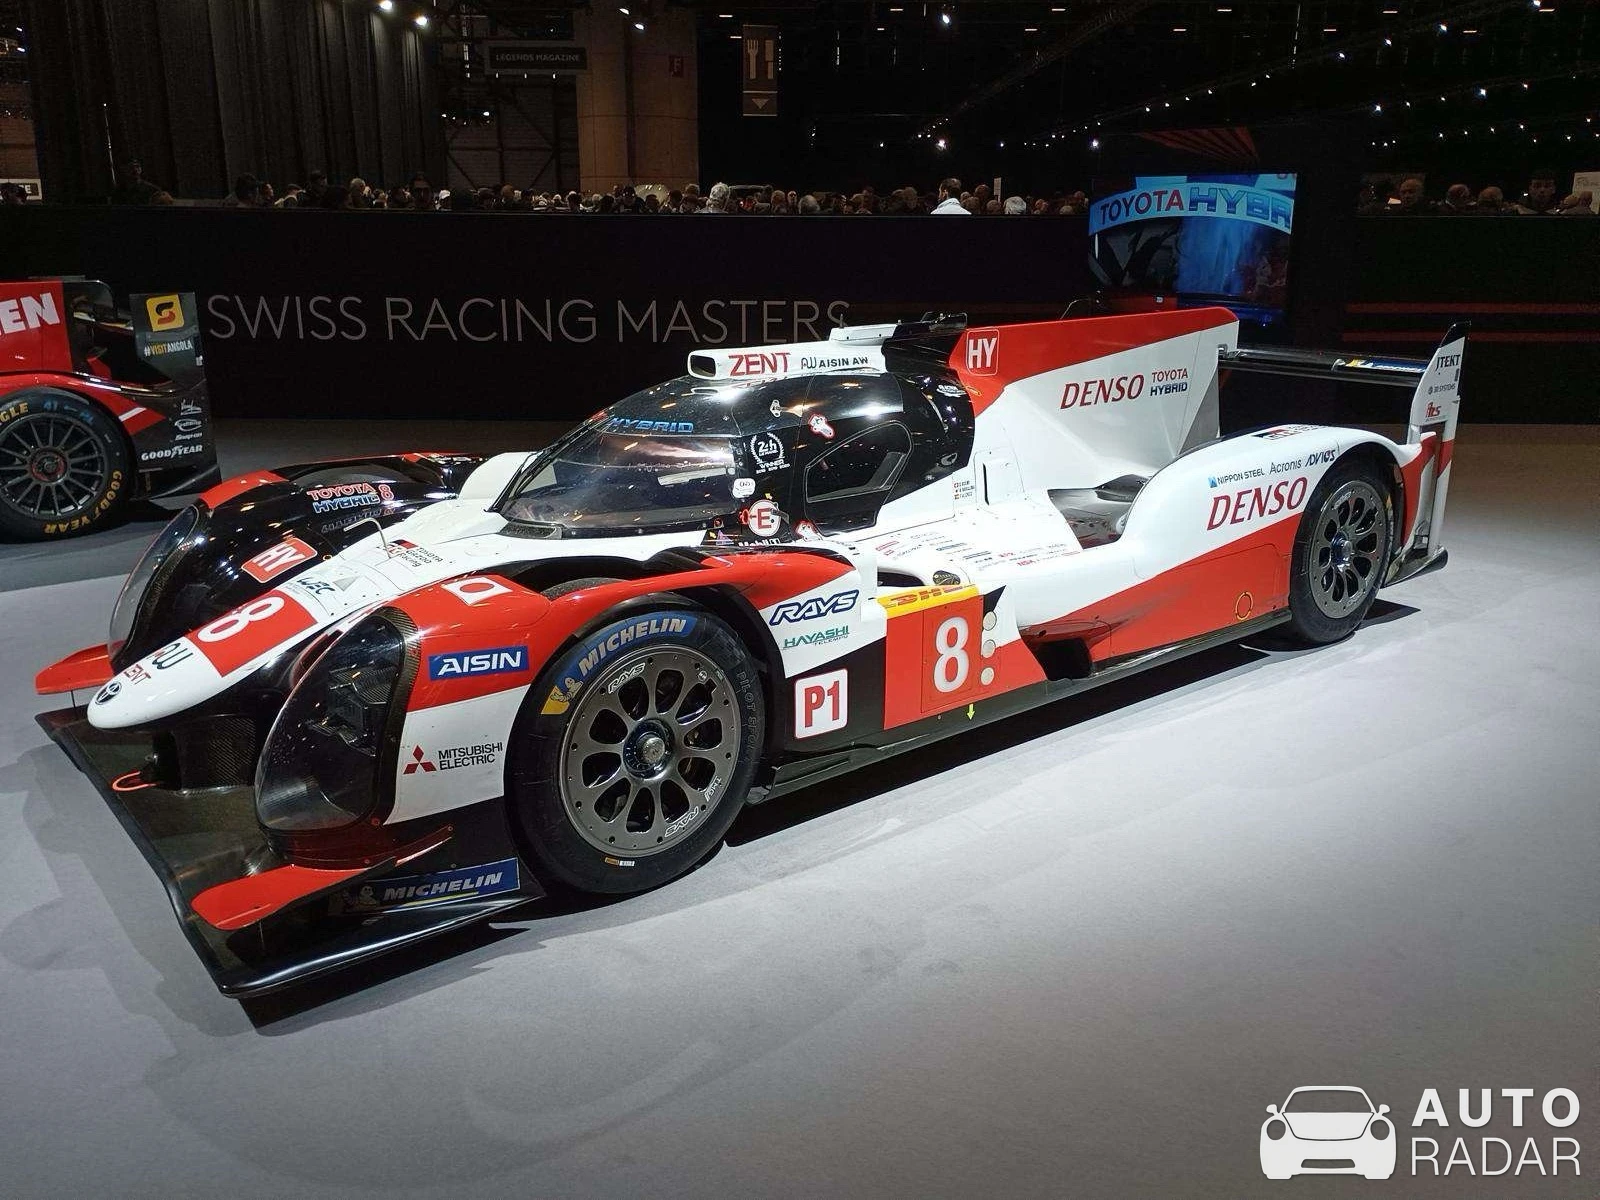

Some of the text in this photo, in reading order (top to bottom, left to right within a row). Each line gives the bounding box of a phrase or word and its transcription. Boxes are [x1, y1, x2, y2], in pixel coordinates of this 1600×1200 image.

[495, 53, 581, 63] LEGENDS MAGAZINE
[1100, 189, 1184, 224] TOYOTA
[0, 291, 60, 335] EN
[207, 294, 850, 343] SWISS RACING MASTERS
[144, 340, 193, 357] #VISITANGOLA
[967, 337, 997, 369] HY
[728, 352, 791, 377] ZENT
[818, 357, 849, 368] AISIN
[851, 356, 869, 366] AW
[1435, 354, 1461, 371] JTEKT
[1151, 368, 1189, 383] TOYOTA
[1060, 374, 1145, 409] DENSO
[1150, 381, 1188, 397] HYBRID
[610, 417, 694, 433] HYBRID
[141, 444, 203, 461] GOODYEAR
[1216, 472, 1244, 486] NIPPON
[1244, 468, 1266, 479] STEEL
[1269, 459, 1302, 475] Acronis
[307, 482, 376, 501] TOYOTA
[312, 493, 381, 514] HYBRID
[378, 483, 395, 501] 8
[1206, 476, 1308, 531] DENSO
[757, 507, 772, 529] E
[251, 544, 306, 572] HY
[198, 596, 285, 643] 8
[769, 588, 859, 626] RAYS
[578, 617, 687, 677] MICHELIN
[784, 625, 849, 648] HAYASHI
[437, 651, 522, 676] AISIN
[933, 616, 970, 694] 8
[607, 662, 646, 694] RAYS
[804, 680, 840, 728] P1
[438, 741, 503, 760] MITSUBISHI
[439, 753, 496, 771] ELECTRIC
[664, 805, 699, 838] RAYS
[383, 872, 503, 901] MICHELIN
